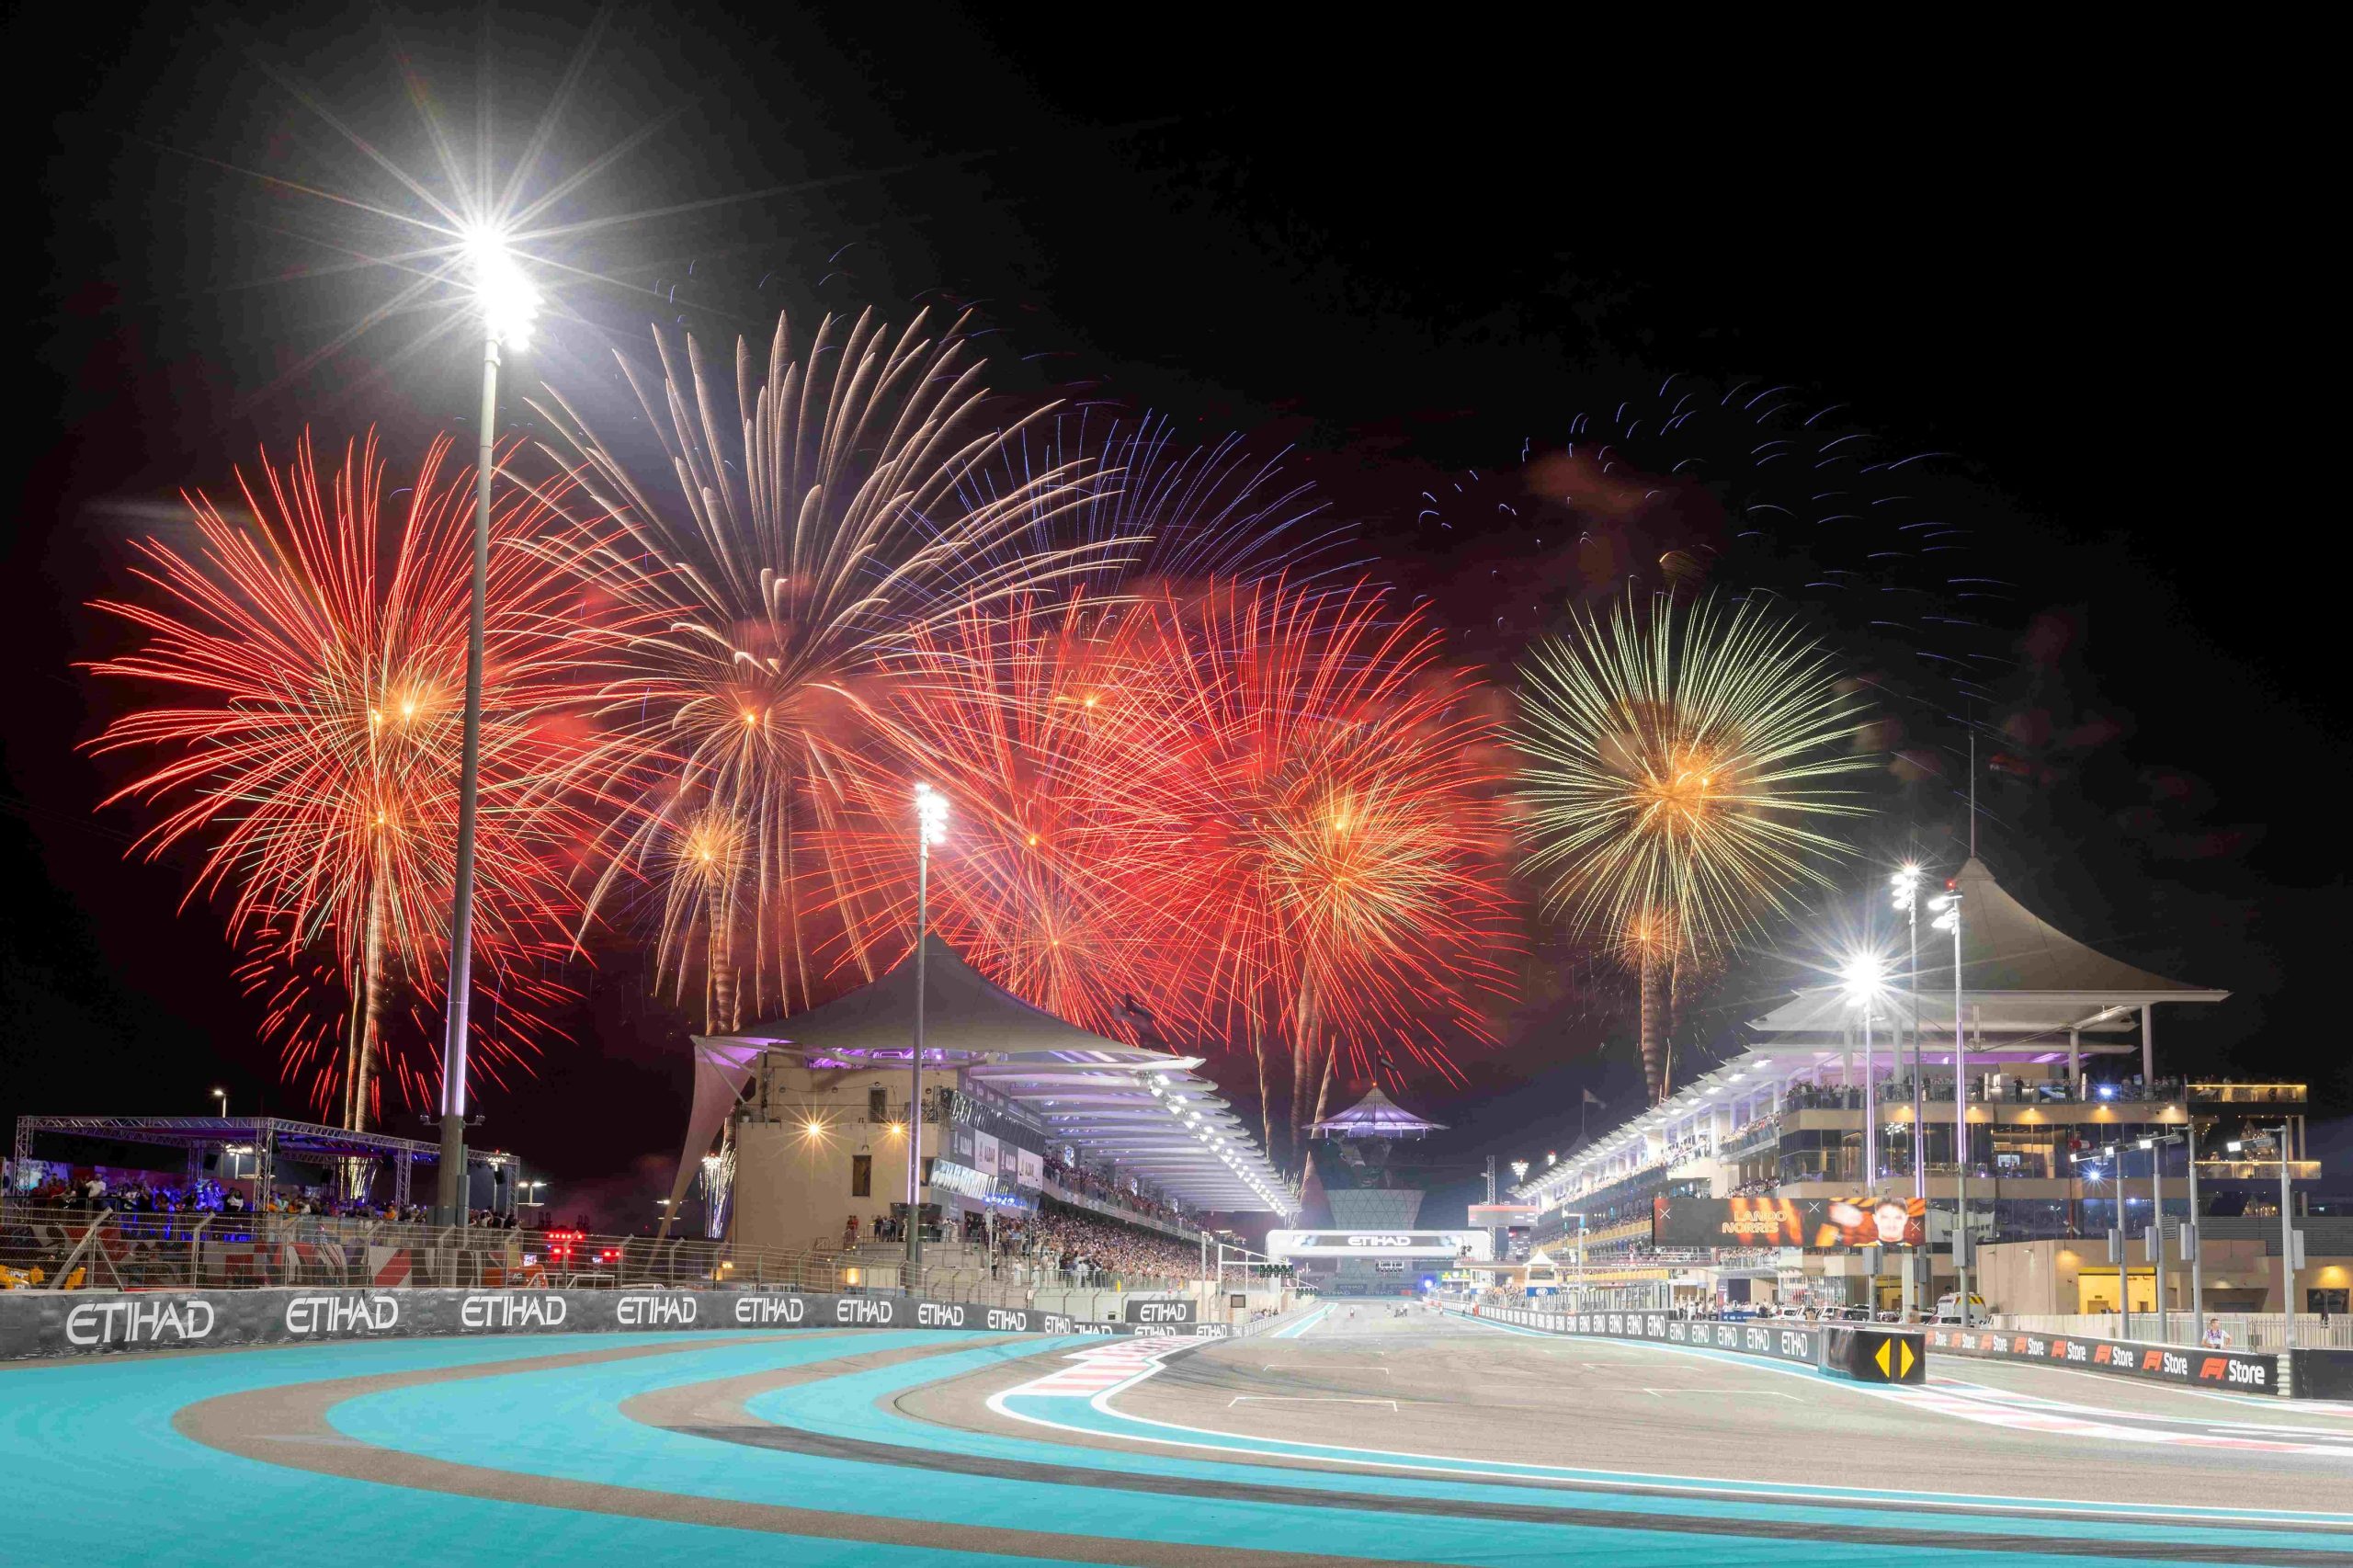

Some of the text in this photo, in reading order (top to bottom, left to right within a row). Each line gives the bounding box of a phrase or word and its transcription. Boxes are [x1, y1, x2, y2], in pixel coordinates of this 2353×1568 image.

[1733, 1210, 1787, 1221] LANDO
[1722, 1222, 1779, 1233] NORRIS
[1347, 1236, 1411, 1246] ETIHAD
[286, 1296, 399, 1333] ETIHAD
[461, 1296, 566, 1327] ETIHAD
[617, 1297, 697, 1324] ETIHAD
[735, 1297, 803, 1322] ETIHAD
[836, 1300, 893, 1324] ETIHAD
[917, 1303, 963, 1326] ETIHAD
[987, 1309, 1026, 1331] ETIHAD
[1140, 1303, 1186, 1322] ETIHAD
[66, 1301, 214, 1345] ETIHAD
[1044, 1315, 1070, 1334] ETIHAD
[1197, 1325, 1227, 1337] ETIHAD
[1627, 1315, 1643, 1335] ETIHAD
[1647, 1315, 1665, 1336] ETIHAD
[1670, 1324, 1686, 1341] ETIHAD
[1692, 1324, 1710, 1344] ETIHAD
[1718, 1325, 1737, 1347] ETIHAD
[1746, 1328, 1770, 1351] ETIHAD
[1781, 1331, 1807, 1357] ETIHAD
[1961, 1333, 1975, 1349] Store
[1993, 1335, 2007, 1352] Store
[2028, 1337, 2044, 1356] Store
[2067, 1341, 2086, 1360] Store
[2112, 1346, 2134, 1368] Store
[2164, 1351, 2188, 1375] Store
[2229, 1360, 2265, 1384] Store
